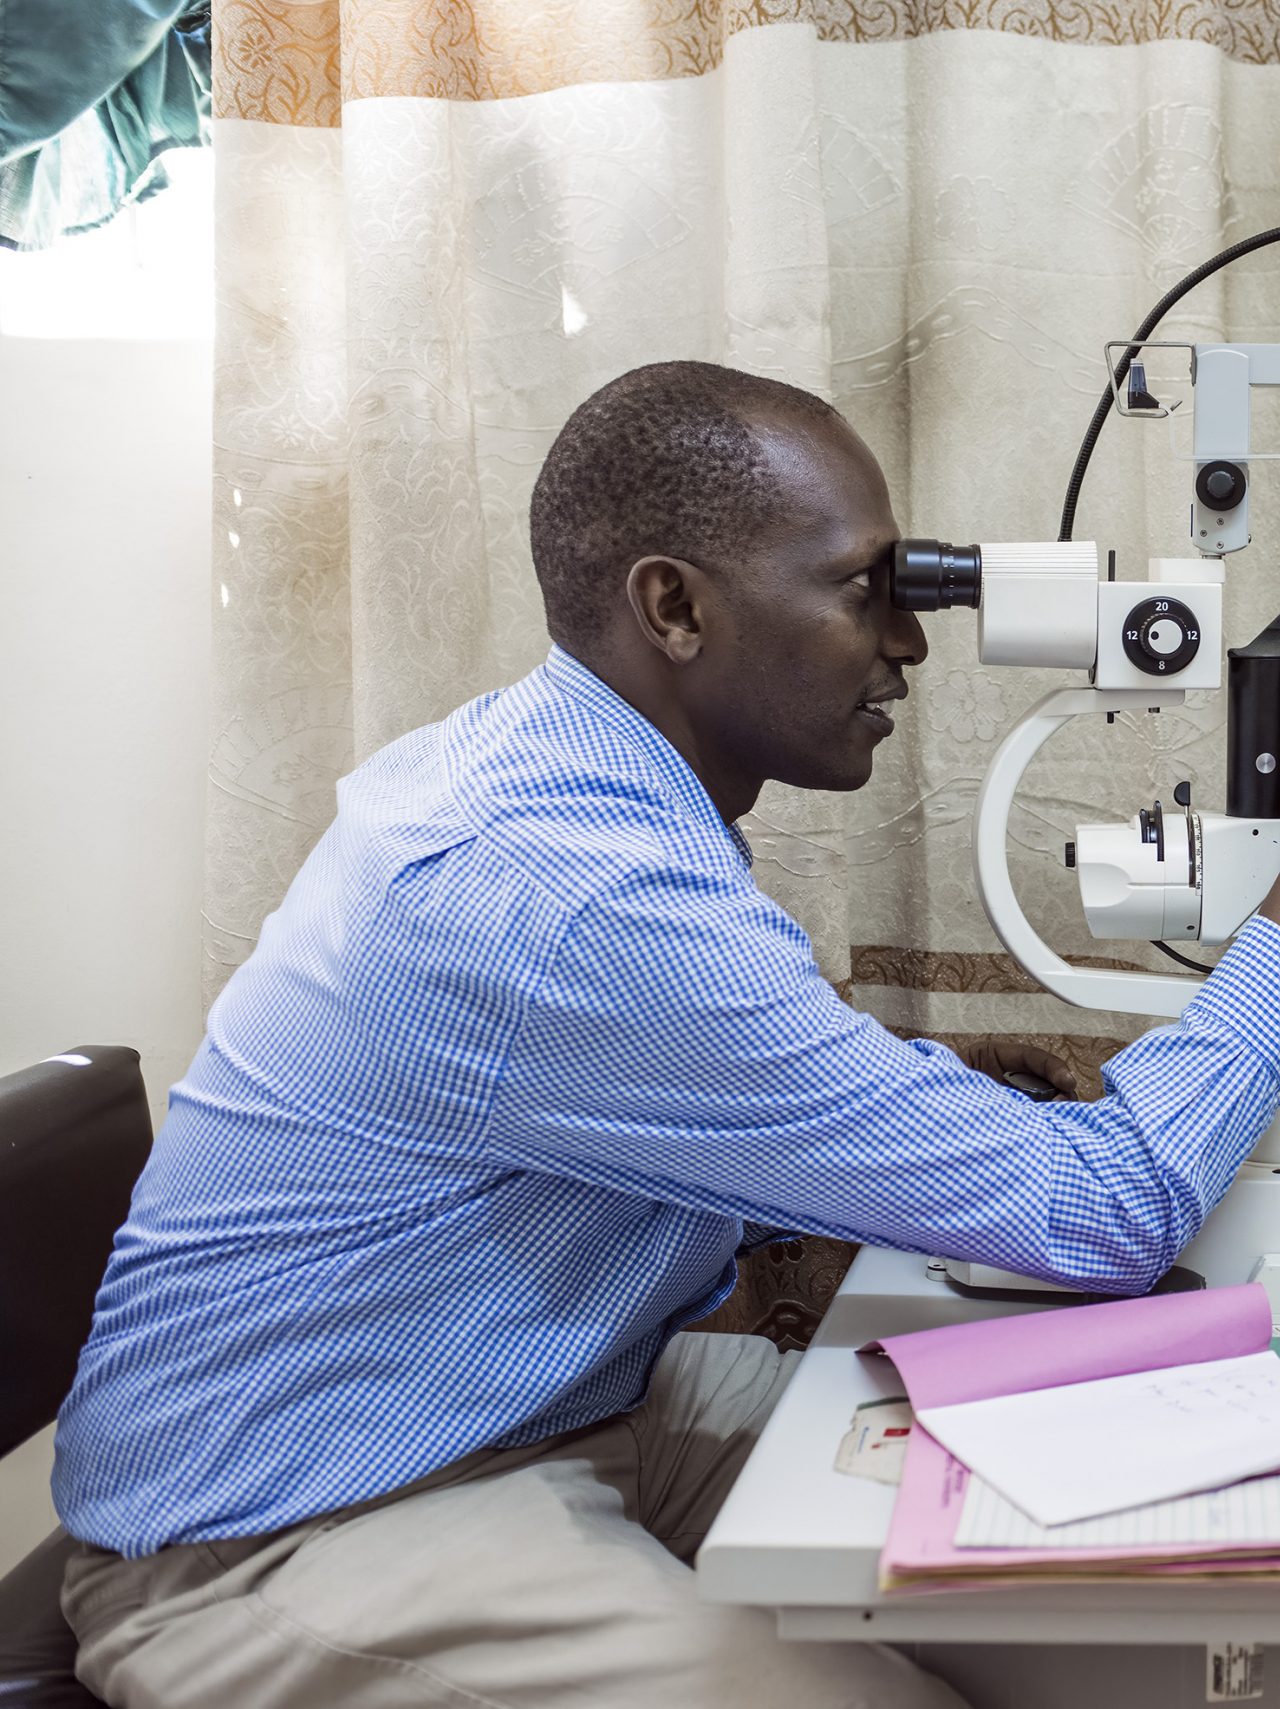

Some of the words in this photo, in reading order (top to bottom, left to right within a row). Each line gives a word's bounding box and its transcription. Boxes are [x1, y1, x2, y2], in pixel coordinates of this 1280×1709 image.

[1155, 602, 1168, 611] 20
[1126, 631, 1138, 640] 12
[1187, 631, 1197, 640] 12
[1159, 661, 1165, 670] 8
